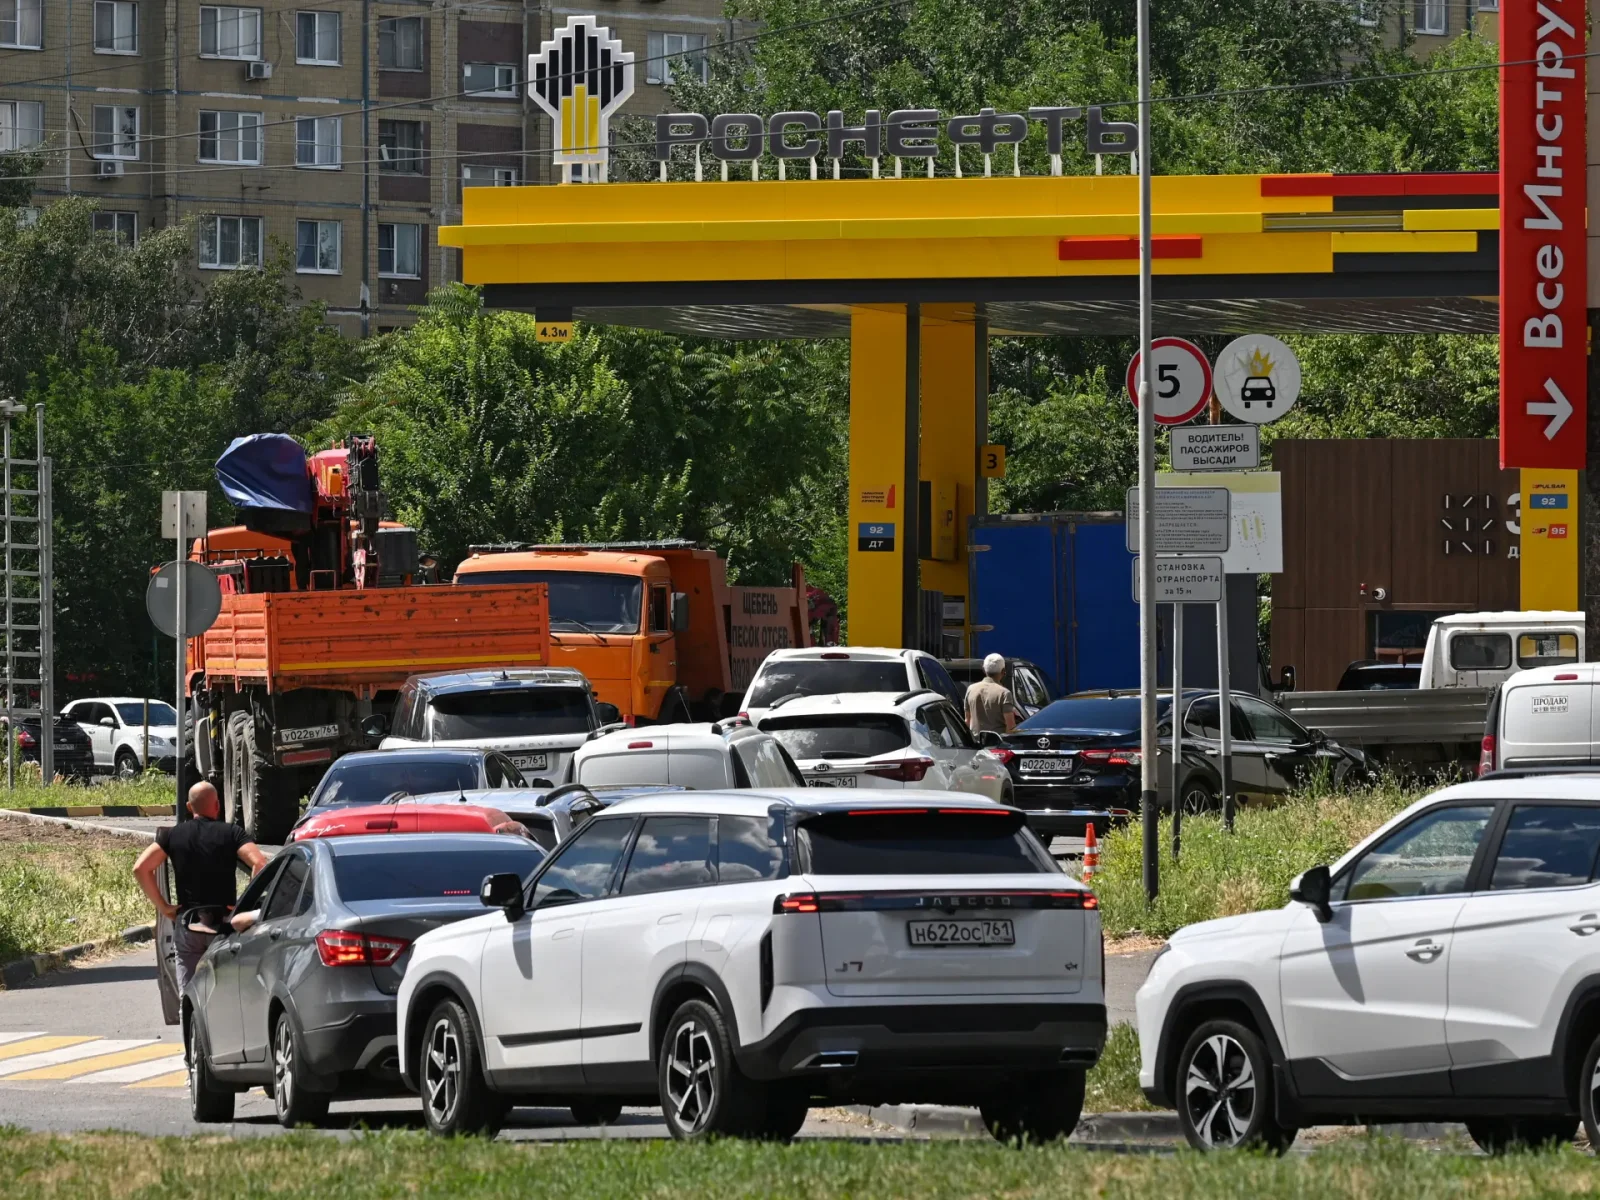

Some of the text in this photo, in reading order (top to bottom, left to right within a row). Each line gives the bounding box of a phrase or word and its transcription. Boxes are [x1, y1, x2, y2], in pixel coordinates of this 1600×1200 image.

[655, 107, 1139, 160] РОСНЕФТЬ
[1523, 0, 1575, 348] Все Инстру
[1158, 364, 1181, 399] 5
[1188, 433, 1244, 444] ВОДИТЕЛЬ!
[1181, 444, 1250, 455] ПАССАЖИРОВ
[986, 453, 998, 469] 3
[1193, 456, 1236, 465] ВЫСАДИ
[743, 592, 778, 618] ЩЕБЕНЬ
[732, 625, 788, 648] ПЕСОК ОТСЕВ
[1533, 698, 1568, 706] ПРОДАЮ
[284, 730, 320, 741] У022ВУ
[528, 752, 544, 764] 761
[1022, 759, 1070, 769] В022ОВ 761
[837, 778, 853, 786] 761
[916, 922, 1010, 942] Н622ОС 761
